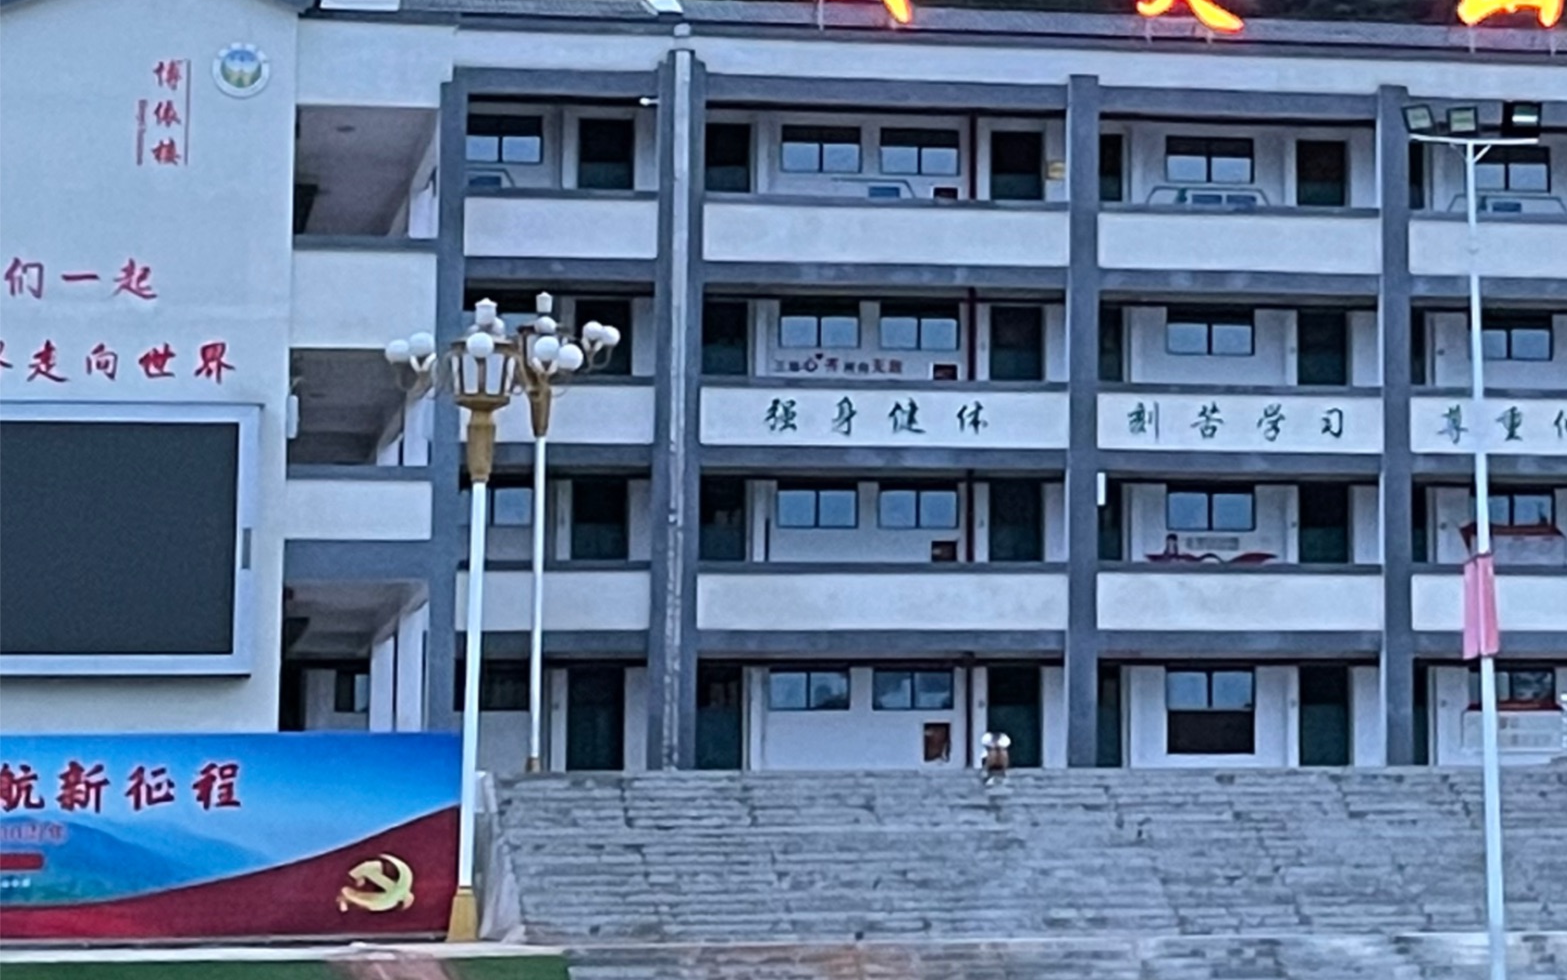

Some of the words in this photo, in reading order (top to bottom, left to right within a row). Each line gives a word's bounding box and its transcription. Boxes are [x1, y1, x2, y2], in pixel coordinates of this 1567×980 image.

[4, 257, 158, 300] 们一起
[764, 396, 990, 436] 强身健体
[1127, 401, 1344, 444] 刻苦学习
